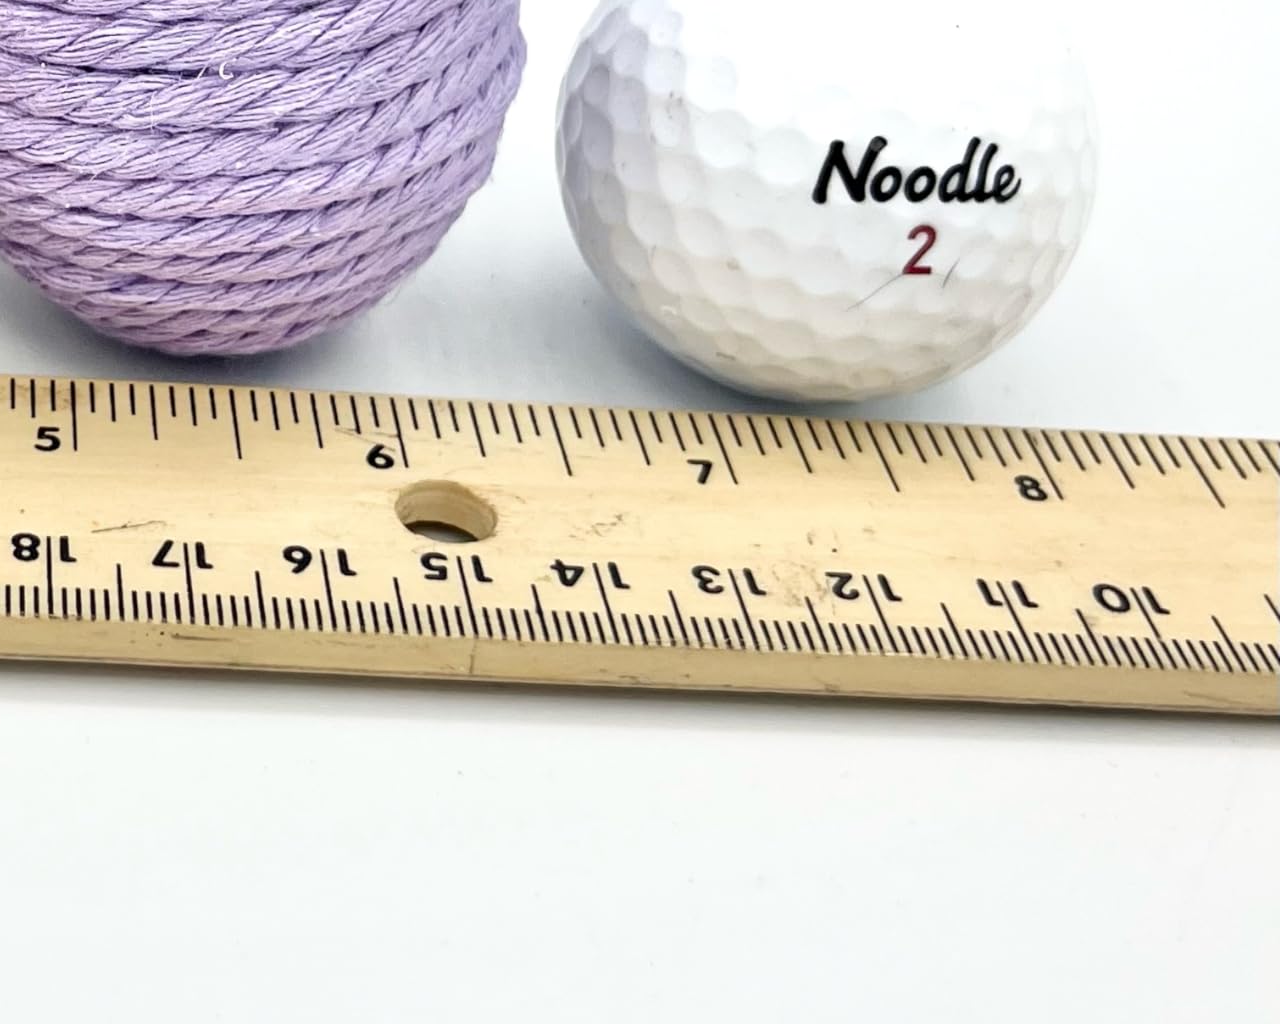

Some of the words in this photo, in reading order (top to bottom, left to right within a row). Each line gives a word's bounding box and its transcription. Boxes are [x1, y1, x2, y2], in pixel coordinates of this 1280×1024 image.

[811, 136, 1021, 204] Noodle
[902, 224, 936, 275] 2
[34, 426, 61, 451] 5
[366, 444, 394, 469] 6
[687, 459, 714, 484] 7
[1015, 475, 1048, 501] 8
